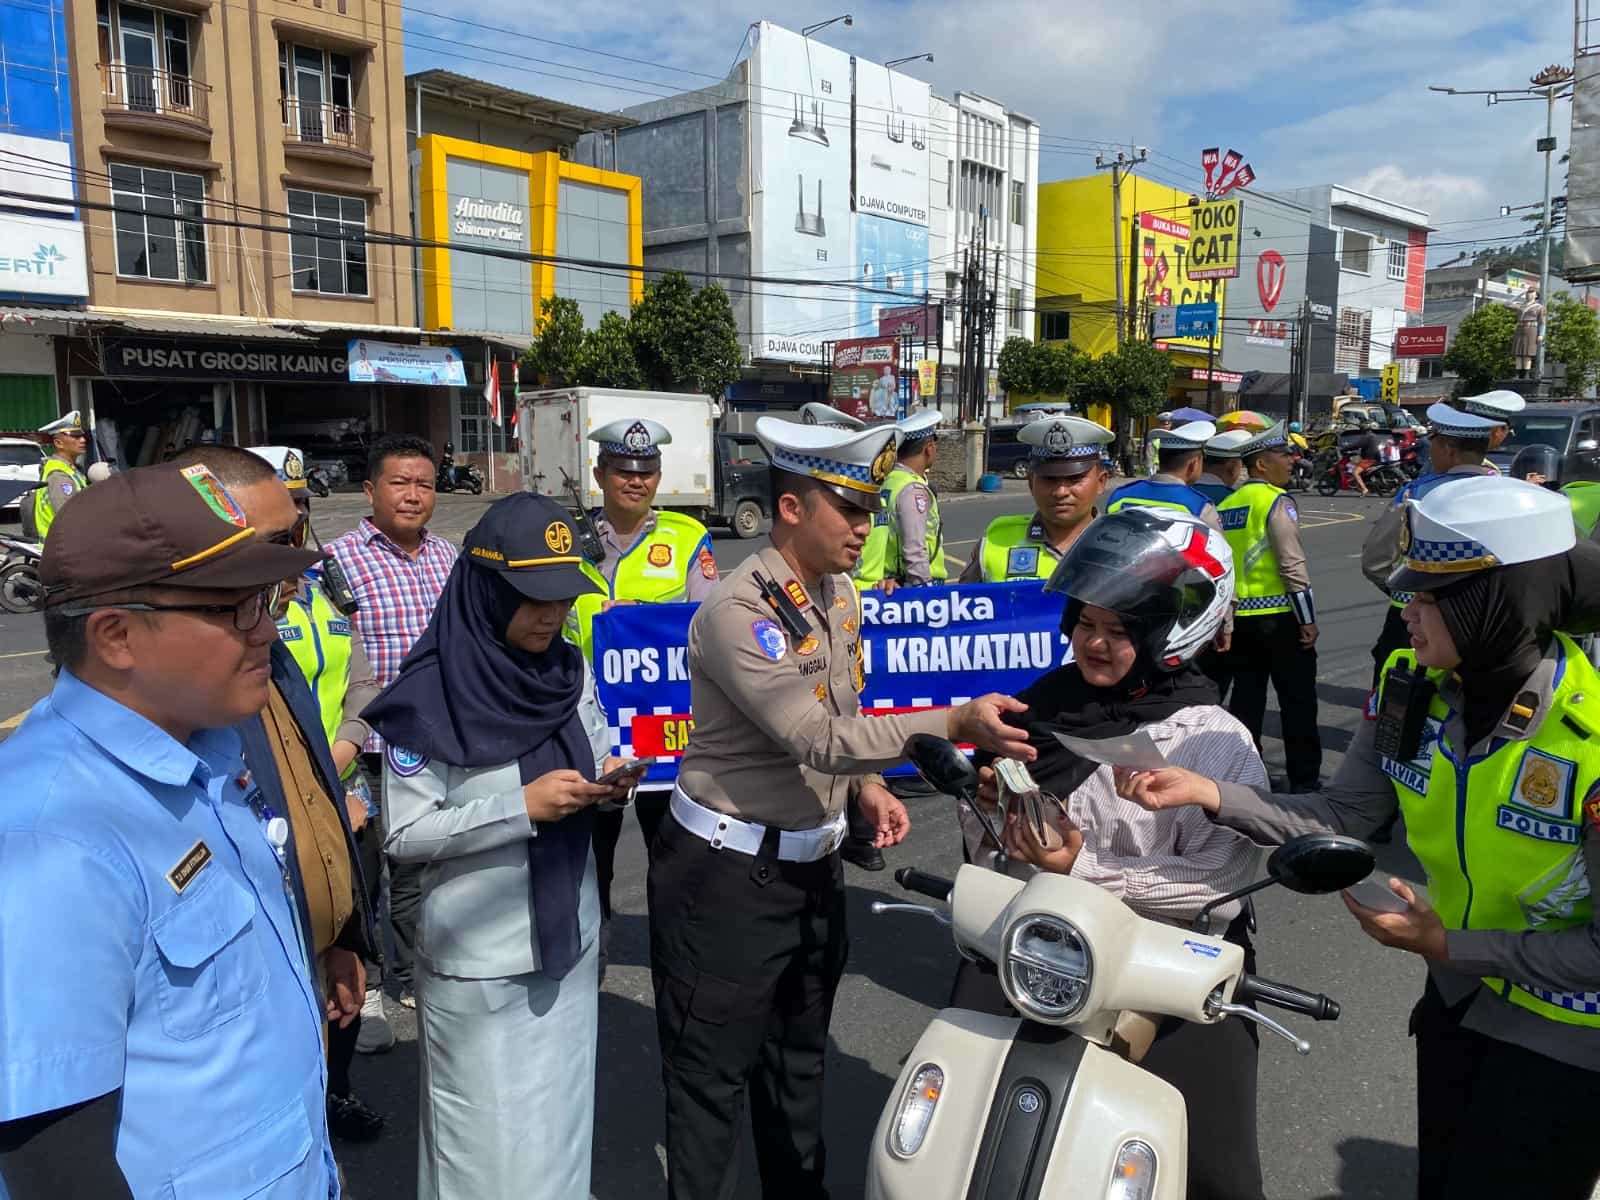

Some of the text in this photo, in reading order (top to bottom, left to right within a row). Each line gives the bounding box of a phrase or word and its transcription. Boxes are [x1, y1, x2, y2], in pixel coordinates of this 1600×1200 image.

[455, 198, 523, 225] Anindita
[886, 201, 927, 220] COMPUTER
[1192, 205, 1236, 230] TOKO
[498, 227, 523, 240] Clinic
[1192, 234, 1233, 265] CAT
[1410, 335, 1445, 344] TAILG
[122, 347, 197, 369] PUSAT
[200, 351, 278, 372] GROSIR
[281, 355, 328, 374] KAIN
[861, 591, 995, 629] Rangka
[602, 648, 659, 684] OPS
[886, 631, 1053, 673] KRAKATAU
[1385, 758, 1426, 790] ALVIRA
[1501, 811, 1574, 841] POLRI
